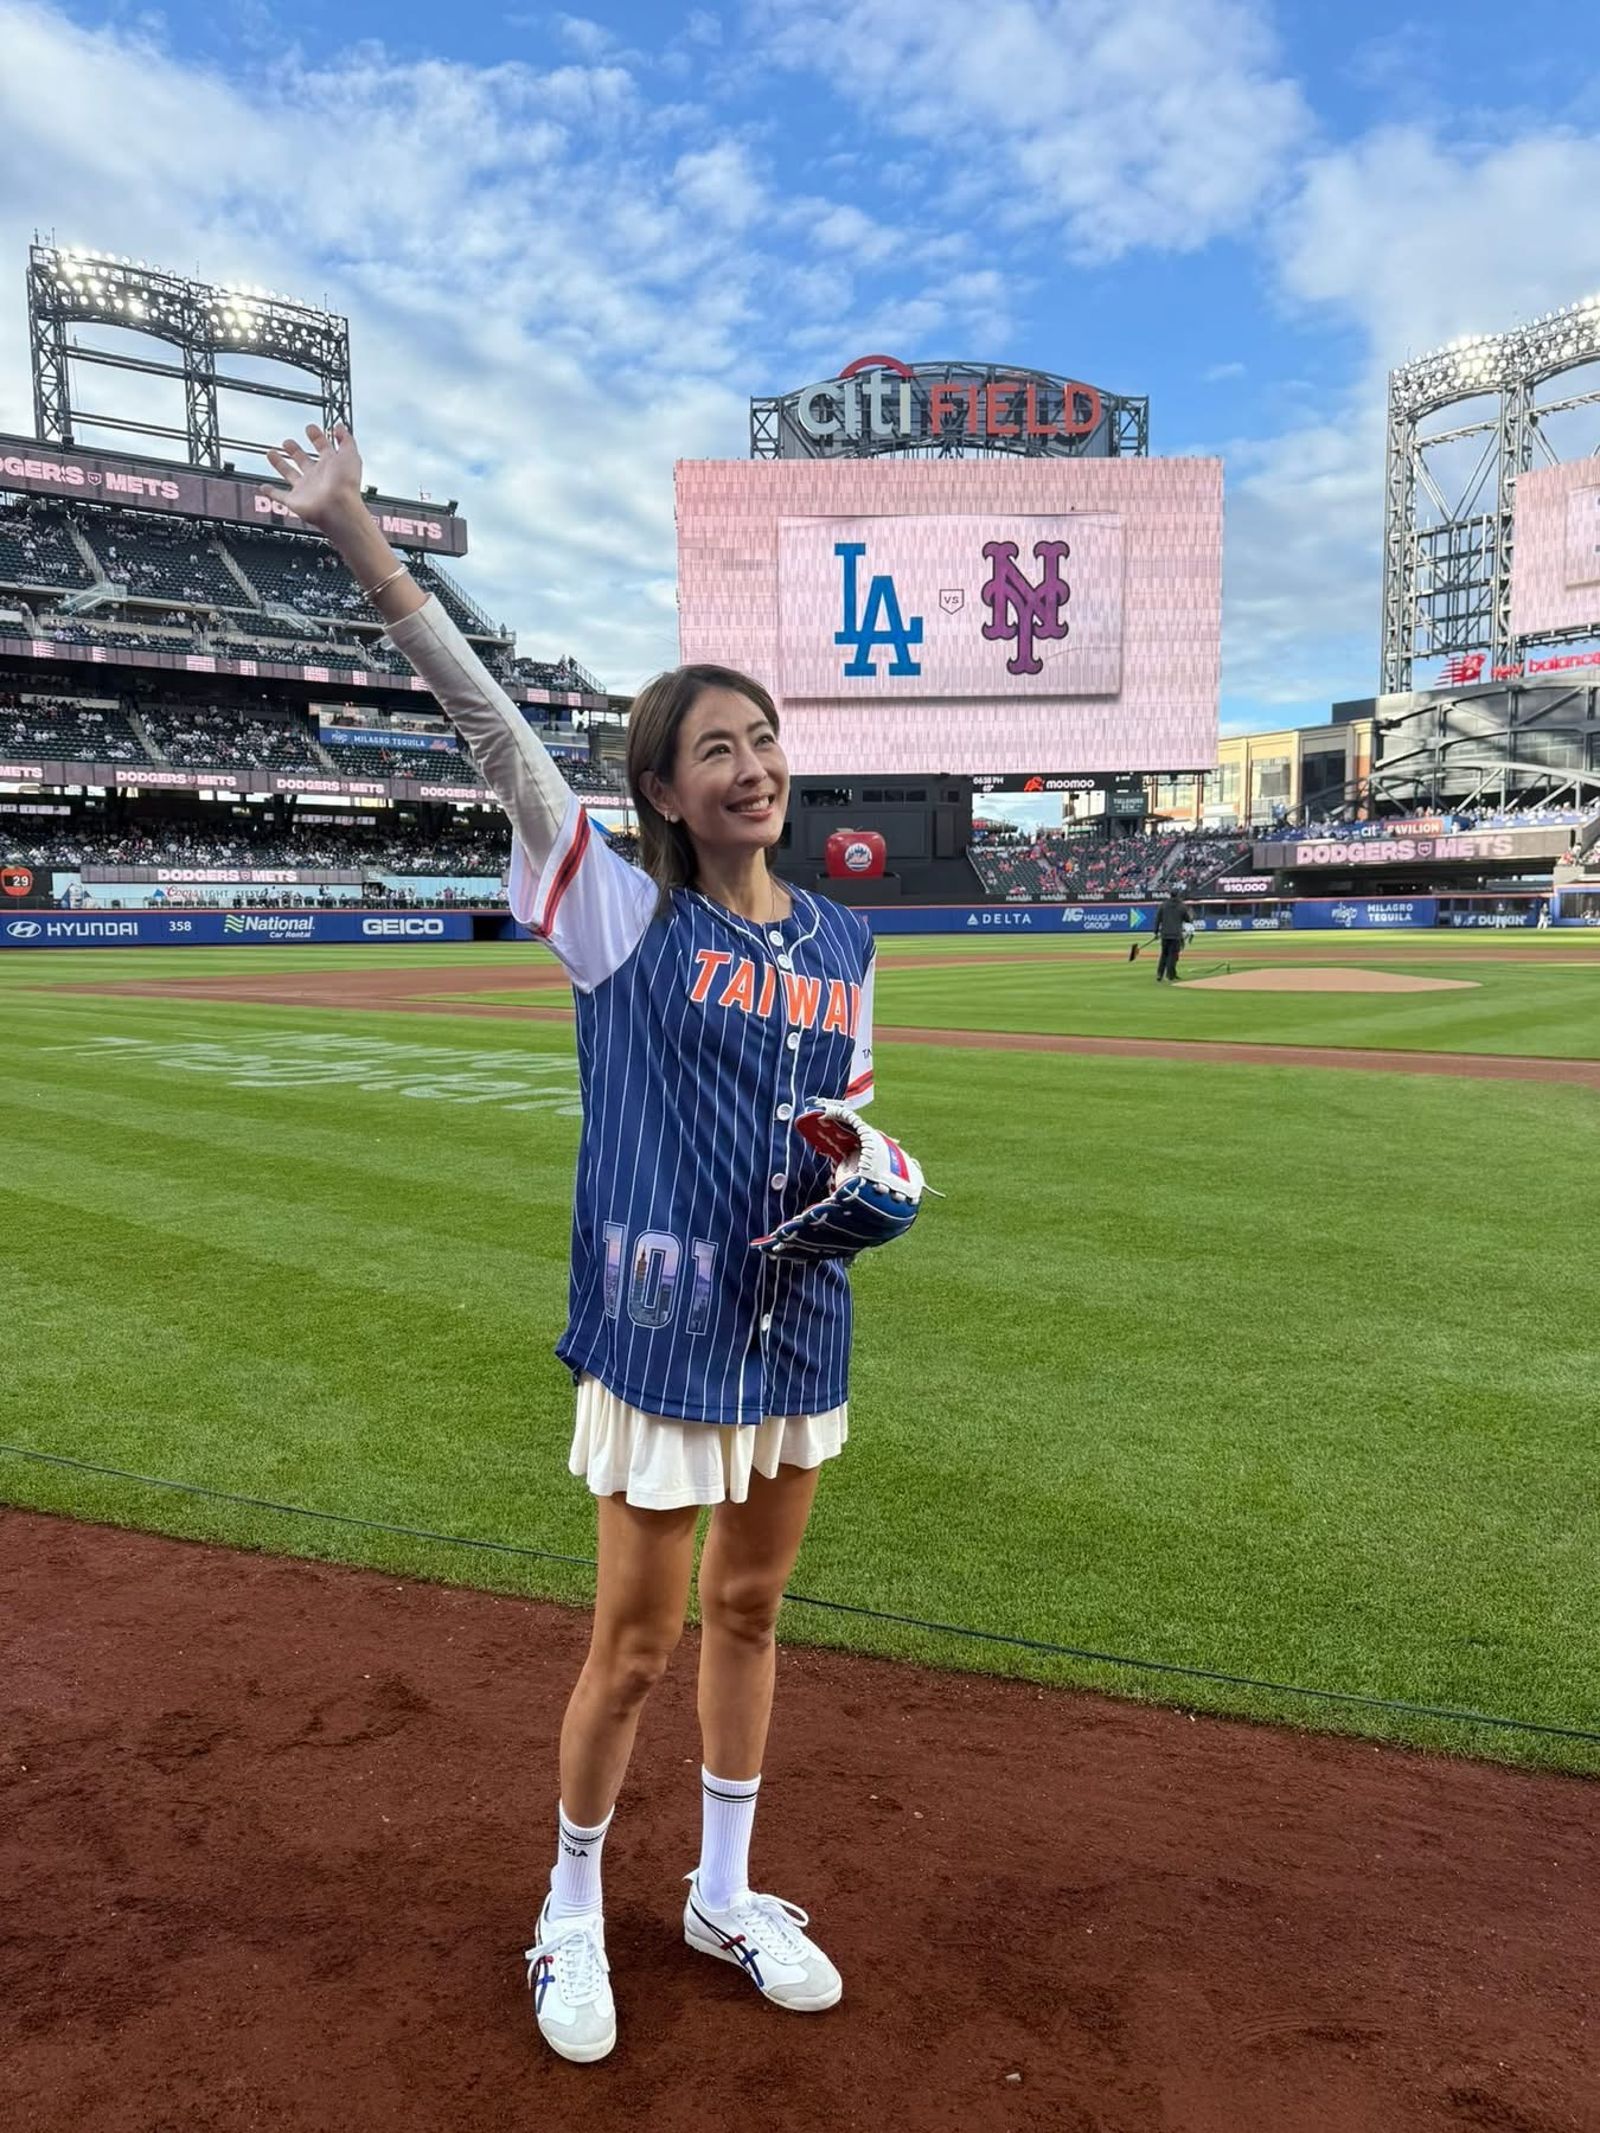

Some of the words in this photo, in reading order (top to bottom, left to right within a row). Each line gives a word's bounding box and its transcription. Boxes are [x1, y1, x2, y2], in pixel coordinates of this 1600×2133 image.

[798, 355, 914, 436] citi
[929, 383, 1101, 435] FIELD
[0, 456, 84, 486] GERS
[105, 471, 180, 499] METS
[382, 515, 442, 539] METS
[834, 543, 923, 677] LA
[981, 540, 1071, 676] NY
[116, 771, 187, 784] DODGERS
[197, 775, 237, 786] METS
[1046, 778, 1095, 790] moomoo
[277, 779, 340, 791] DODGERS
[349, 782, 385, 794] METS
[420, 786, 477, 799] DODGERS
[578, 795, 620, 806] ODGERS
[1296, 839, 1416, 866] DODGERS
[1434, 834, 1514, 859] METS
[13, 875, 29, 887] 29
[157, 869, 240, 882] DODGERS
[252, 870, 297, 882] METS
[1367, 903, 1414, 912] MILAGRO
[982, 913, 1032, 924] DELTA
[1084, 914, 1128, 922] HAUGLAND
[1368, 912, 1412, 922] TEQUILA
[47, 922, 139, 936] HYUNDAI
[168, 920, 192, 932] 358
[362, 918, 444, 935] GEICO
[1084, 921, 1112, 930] GROUP
[603, 1220, 719, 1336] 101
